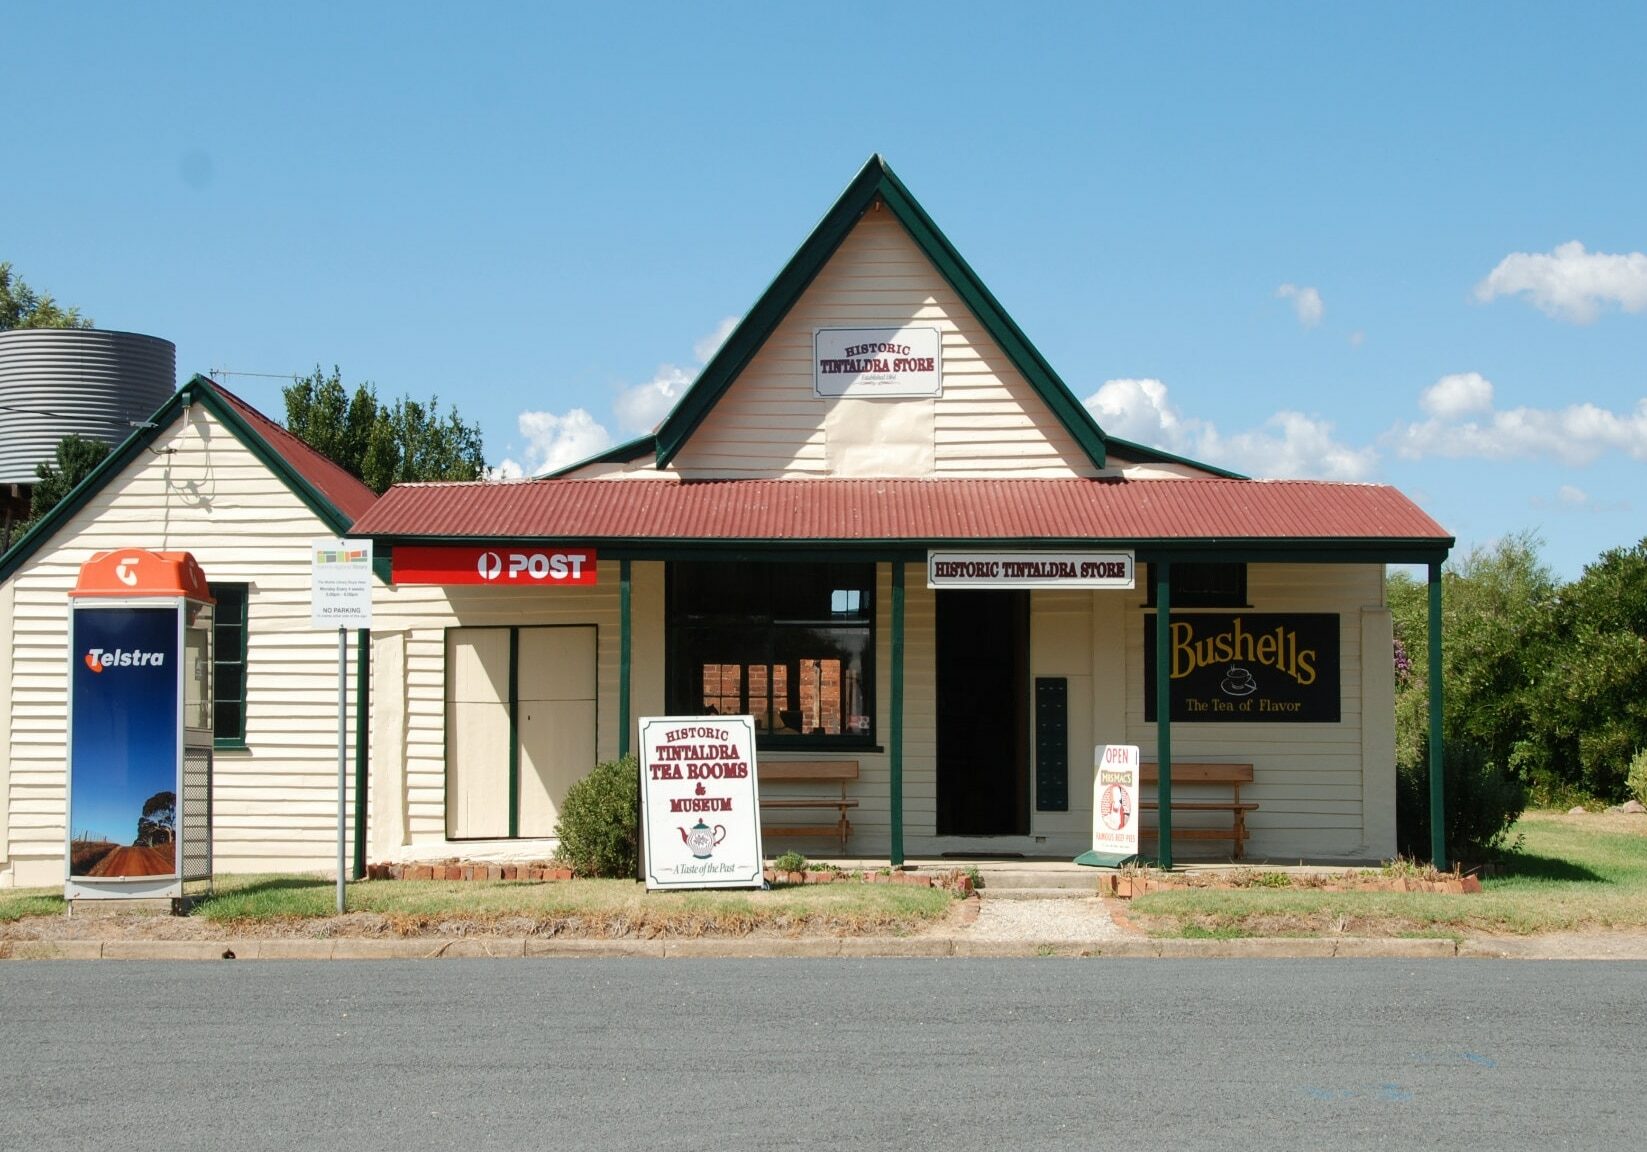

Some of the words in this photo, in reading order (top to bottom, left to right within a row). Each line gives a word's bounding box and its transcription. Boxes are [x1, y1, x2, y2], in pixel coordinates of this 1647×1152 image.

[845, 343, 911, 357] HISTORIC
[821, 359, 890, 373] TINTALDRA
[893, 358, 934, 372] STORE
[508, 553, 586, 579] POST
[935, 561, 999, 578] HISTORIC
[1002, 562, 1077, 578] TINTALDRA
[1080, 562, 1125, 578] STORE
[88, 648, 164, 667] Telstra
[1169, 616, 1317, 685] Bushells
[1185, 698, 1209, 712] The
[1211, 699, 1234, 712] Tea
[1239, 698, 1253, 711] of
[1259, 698, 1301, 712] Flavor
[665, 727, 729, 743] HISTORIC
[656, 744, 740, 761] TINTALDRA
[1106, 748, 1128, 764] OPEN
[650, 763, 684, 780] TEA
[687, 762, 748, 780] ROOMS
[695, 782, 706, 796] &
[670, 798, 733, 812] MUSEUM
[673, 864, 679, 874] A
[680, 863, 698, 874] Taste
[698, 862, 707, 876] of
[707, 862, 719, 873] the
[719, 862, 735, 873] Past
